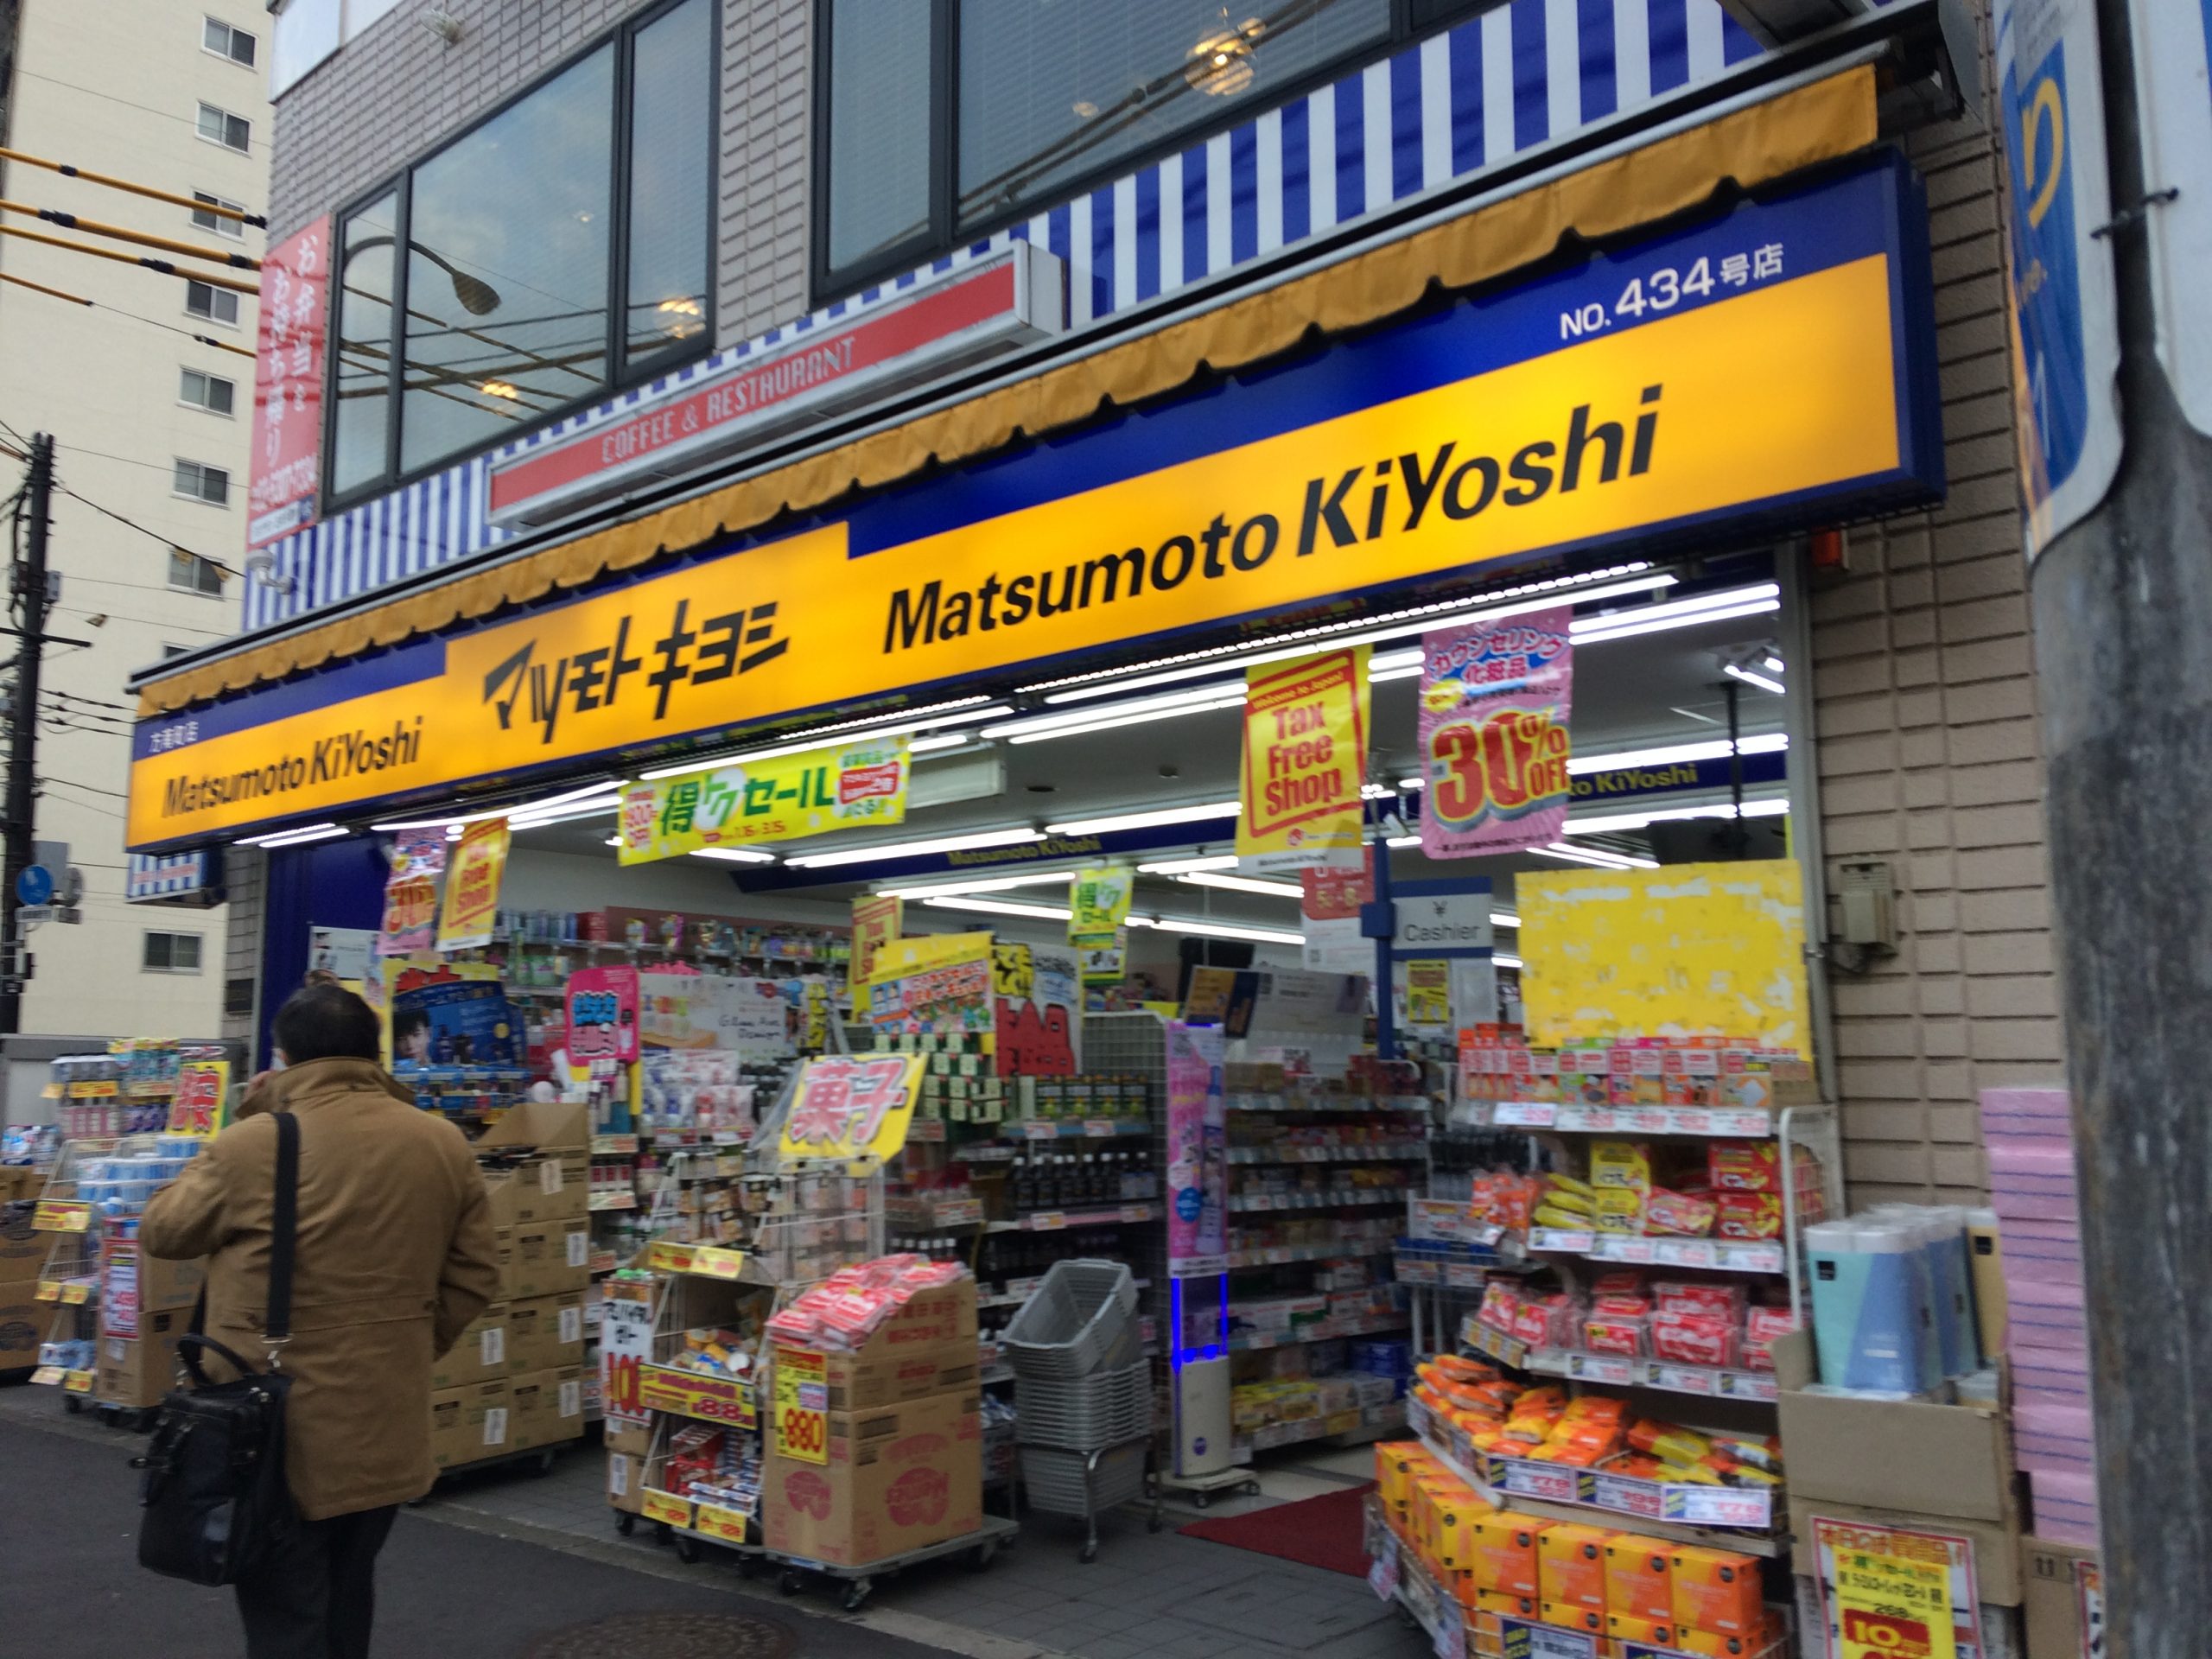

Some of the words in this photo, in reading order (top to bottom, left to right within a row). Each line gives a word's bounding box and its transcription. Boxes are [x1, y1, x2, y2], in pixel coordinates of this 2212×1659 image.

[601, 410, 674, 463] COFFEE
[682, 404, 699, 432] &
[707, 336, 855, 423] RESTAURANT
[883, 513, 1279, 651] Matsumoto
[1296, 384, 1663, 555] KiYoshi
[482, 600, 789, 744] マツモトキヨシ
[1431, 627, 1566, 677] カウンセリング
[1464, 657, 1528, 684] 化粧品
[1272, 701, 1326, 740] Tax
[162, 753, 306, 817] Matsumoto
[309, 715, 423, 784] KiYoshi
[1268, 735, 1332, 779] Free
[1528, 754, 1569, 796] OFF
[1594, 763, 1698, 793] KiYoshi
[1405, 922, 1480, 942] Cashier
[790, 1058, 907, 1145] 菓子
[785, 1408, 822, 1453] 880
[1853, 1620, 1901, 1647] 10
